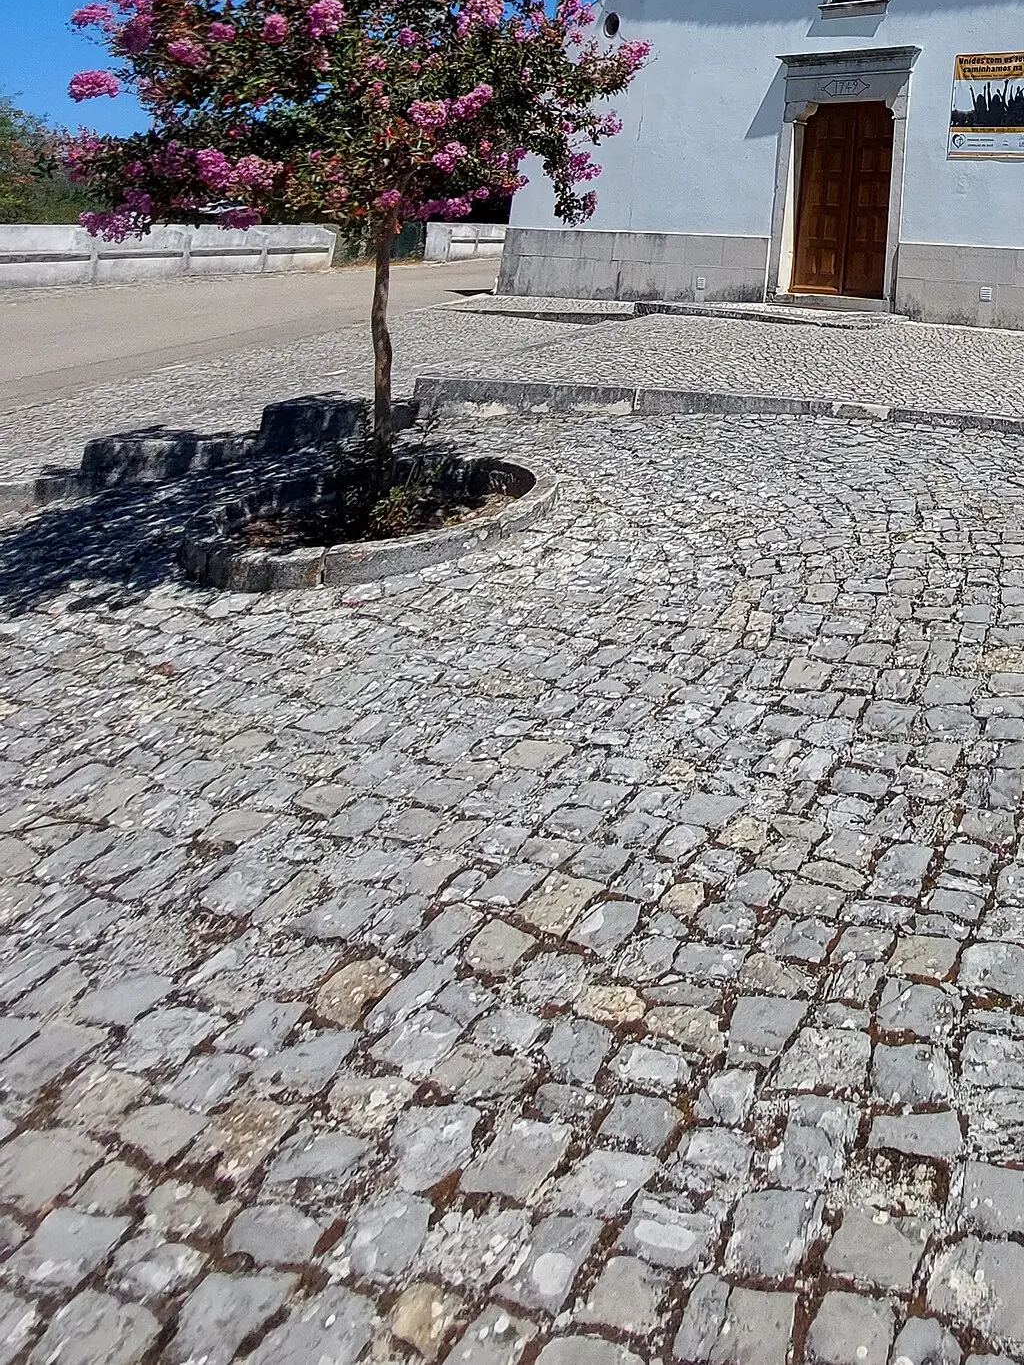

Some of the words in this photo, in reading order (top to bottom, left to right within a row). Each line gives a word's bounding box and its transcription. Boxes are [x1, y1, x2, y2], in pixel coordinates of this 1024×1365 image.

[959, 57, 984, 65] Unidos
[963, 65, 1011, 73] caminhamos
[835, 81, 858, 93] 1749
